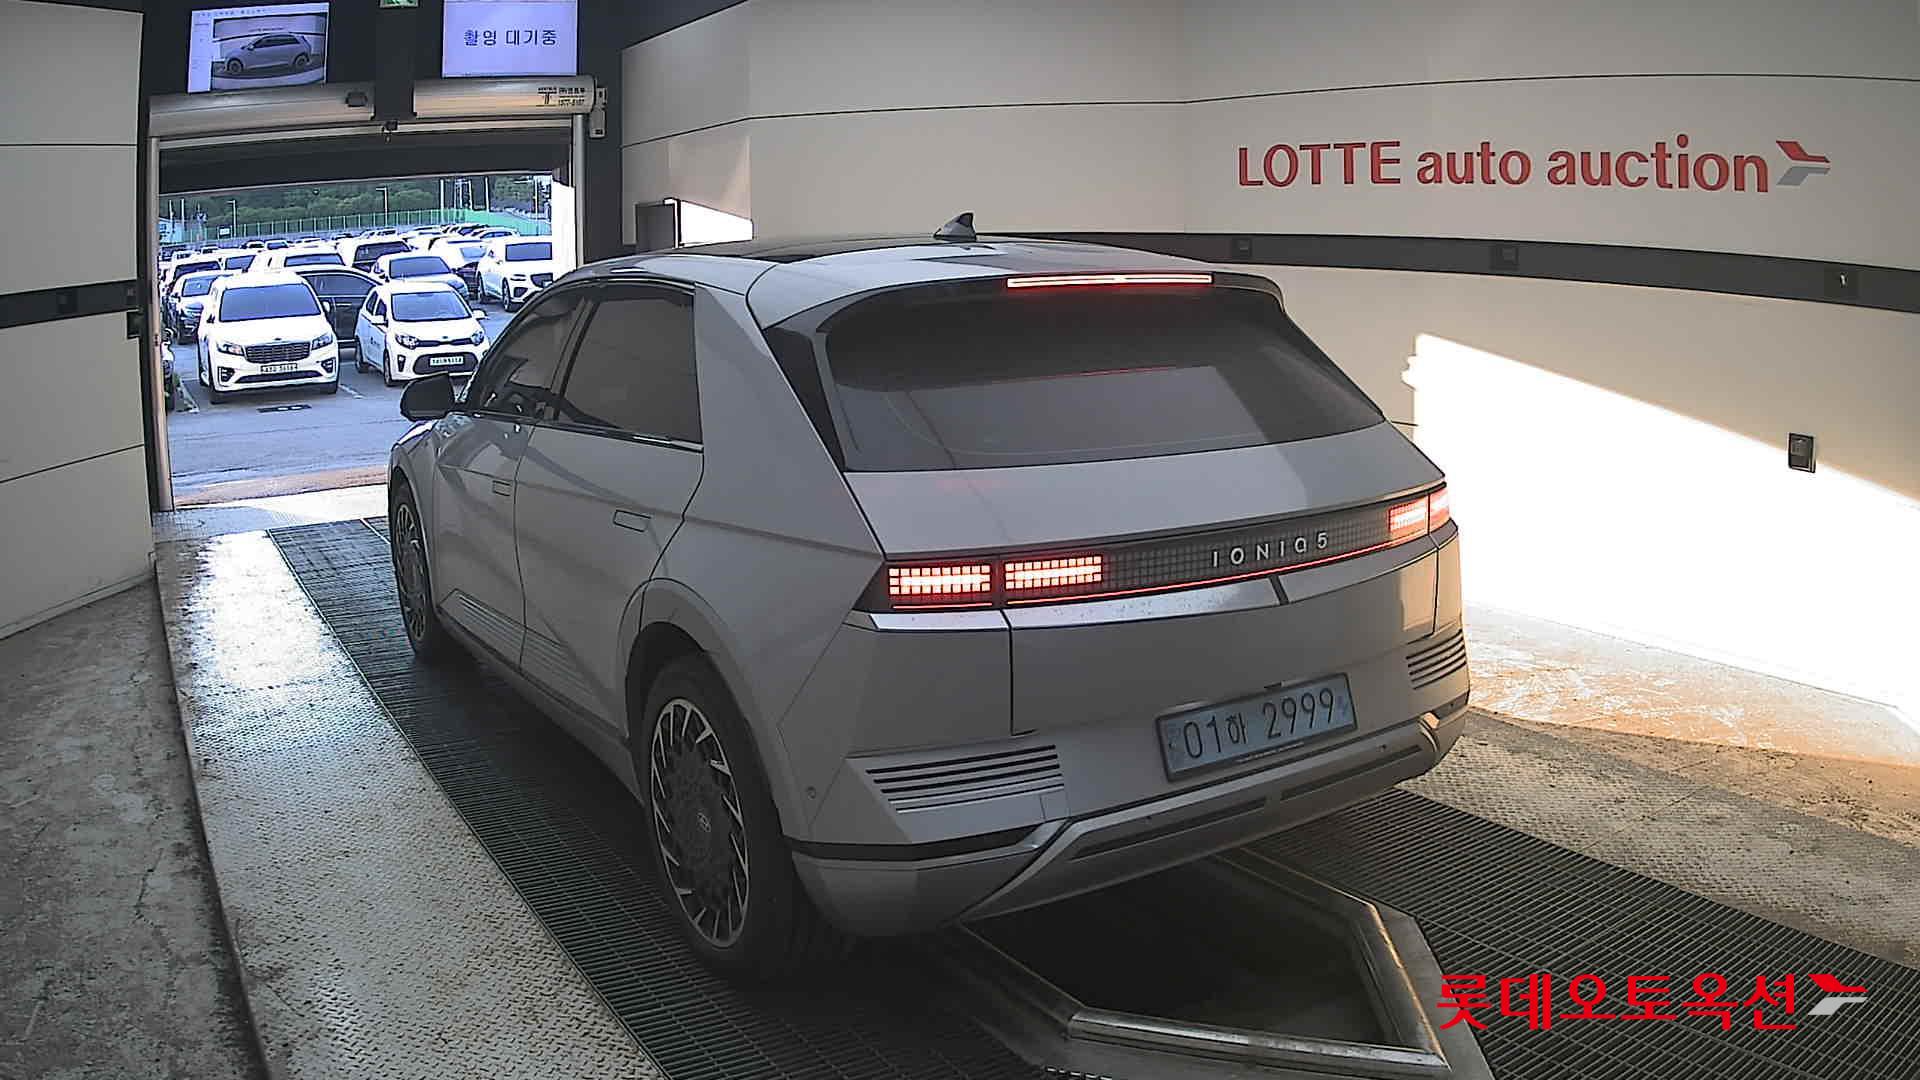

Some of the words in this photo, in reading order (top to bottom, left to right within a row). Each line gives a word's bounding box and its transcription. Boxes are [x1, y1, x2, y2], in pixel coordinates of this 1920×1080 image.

[506, 29, 557, 46] 대기중
[1238, 141, 1401, 187] LOTTE
[1416, 141, 1531, 185] auto
[1547, 134, 1768, 193] auction
[1262, 687, 1334, 739] 2999
